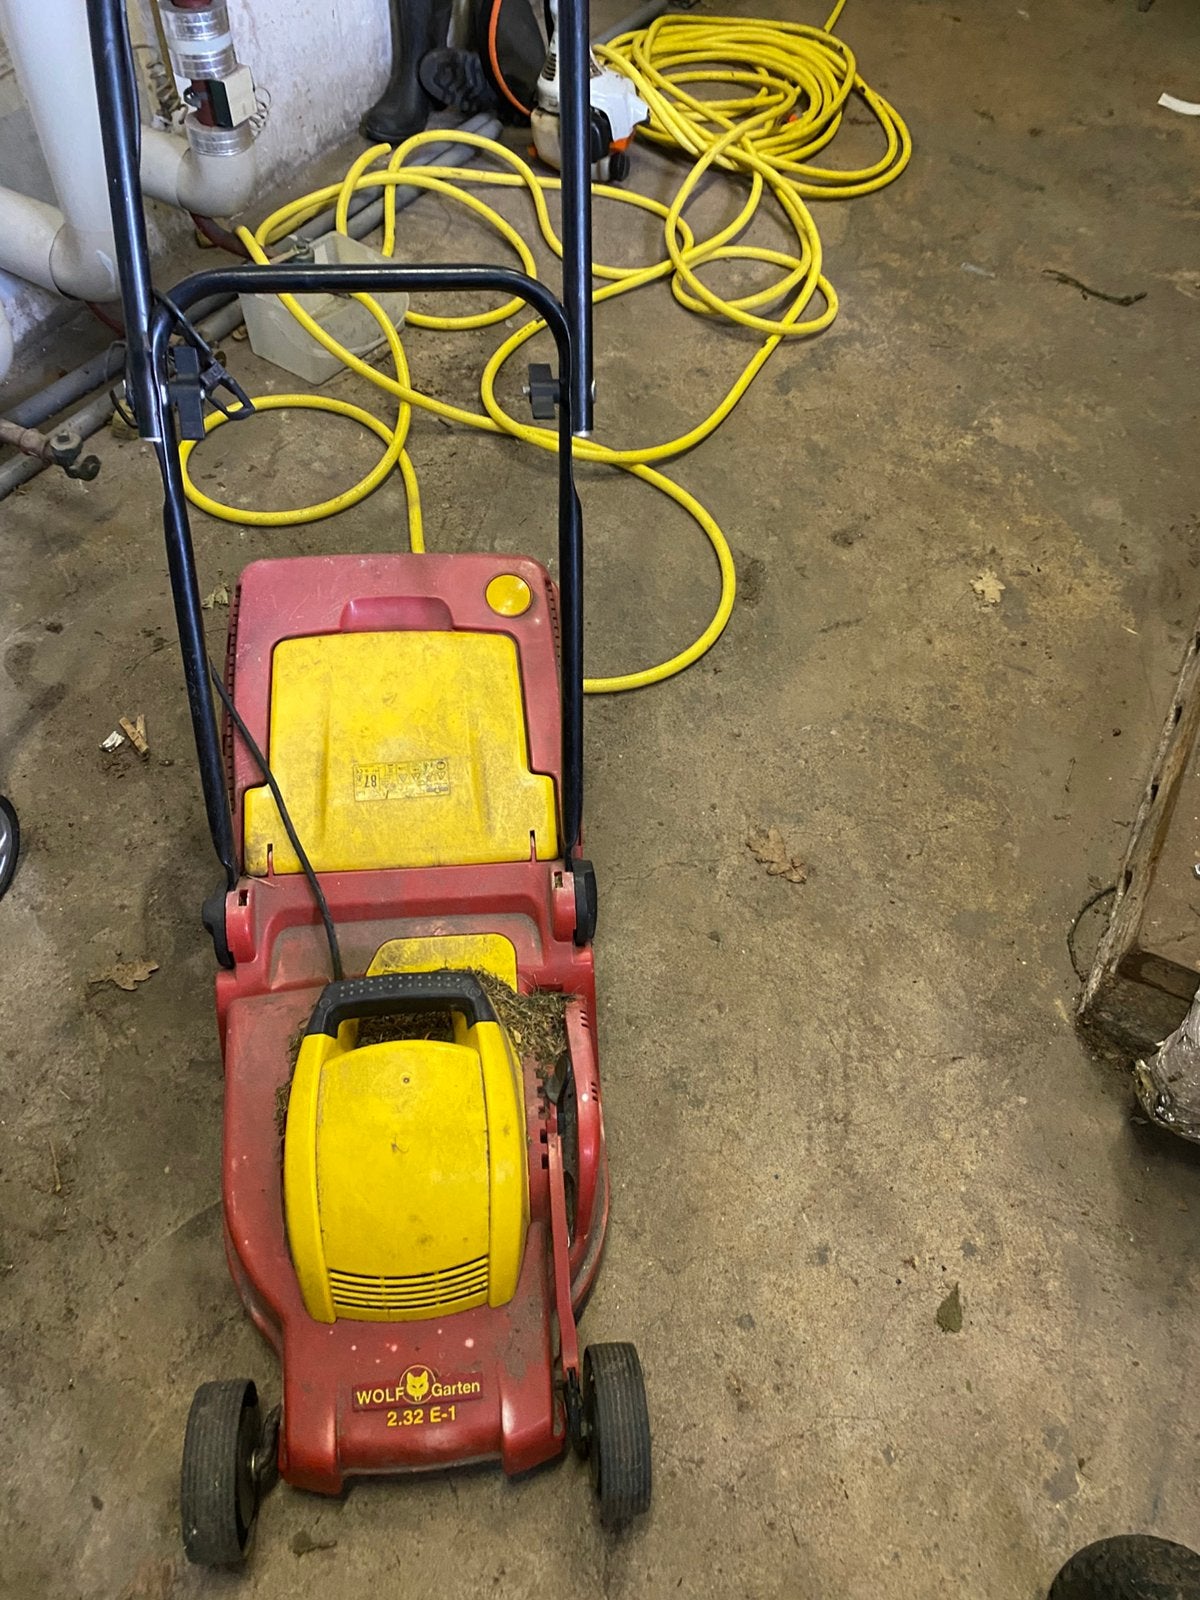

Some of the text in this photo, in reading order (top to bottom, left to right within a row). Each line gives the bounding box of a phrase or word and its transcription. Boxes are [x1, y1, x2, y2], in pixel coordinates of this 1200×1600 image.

[365, 774, 377, 788] 87
[356, 1382, 480, 1405] WOLF Garten
[387, 1405, 456, 1427] 2.32 E-1
